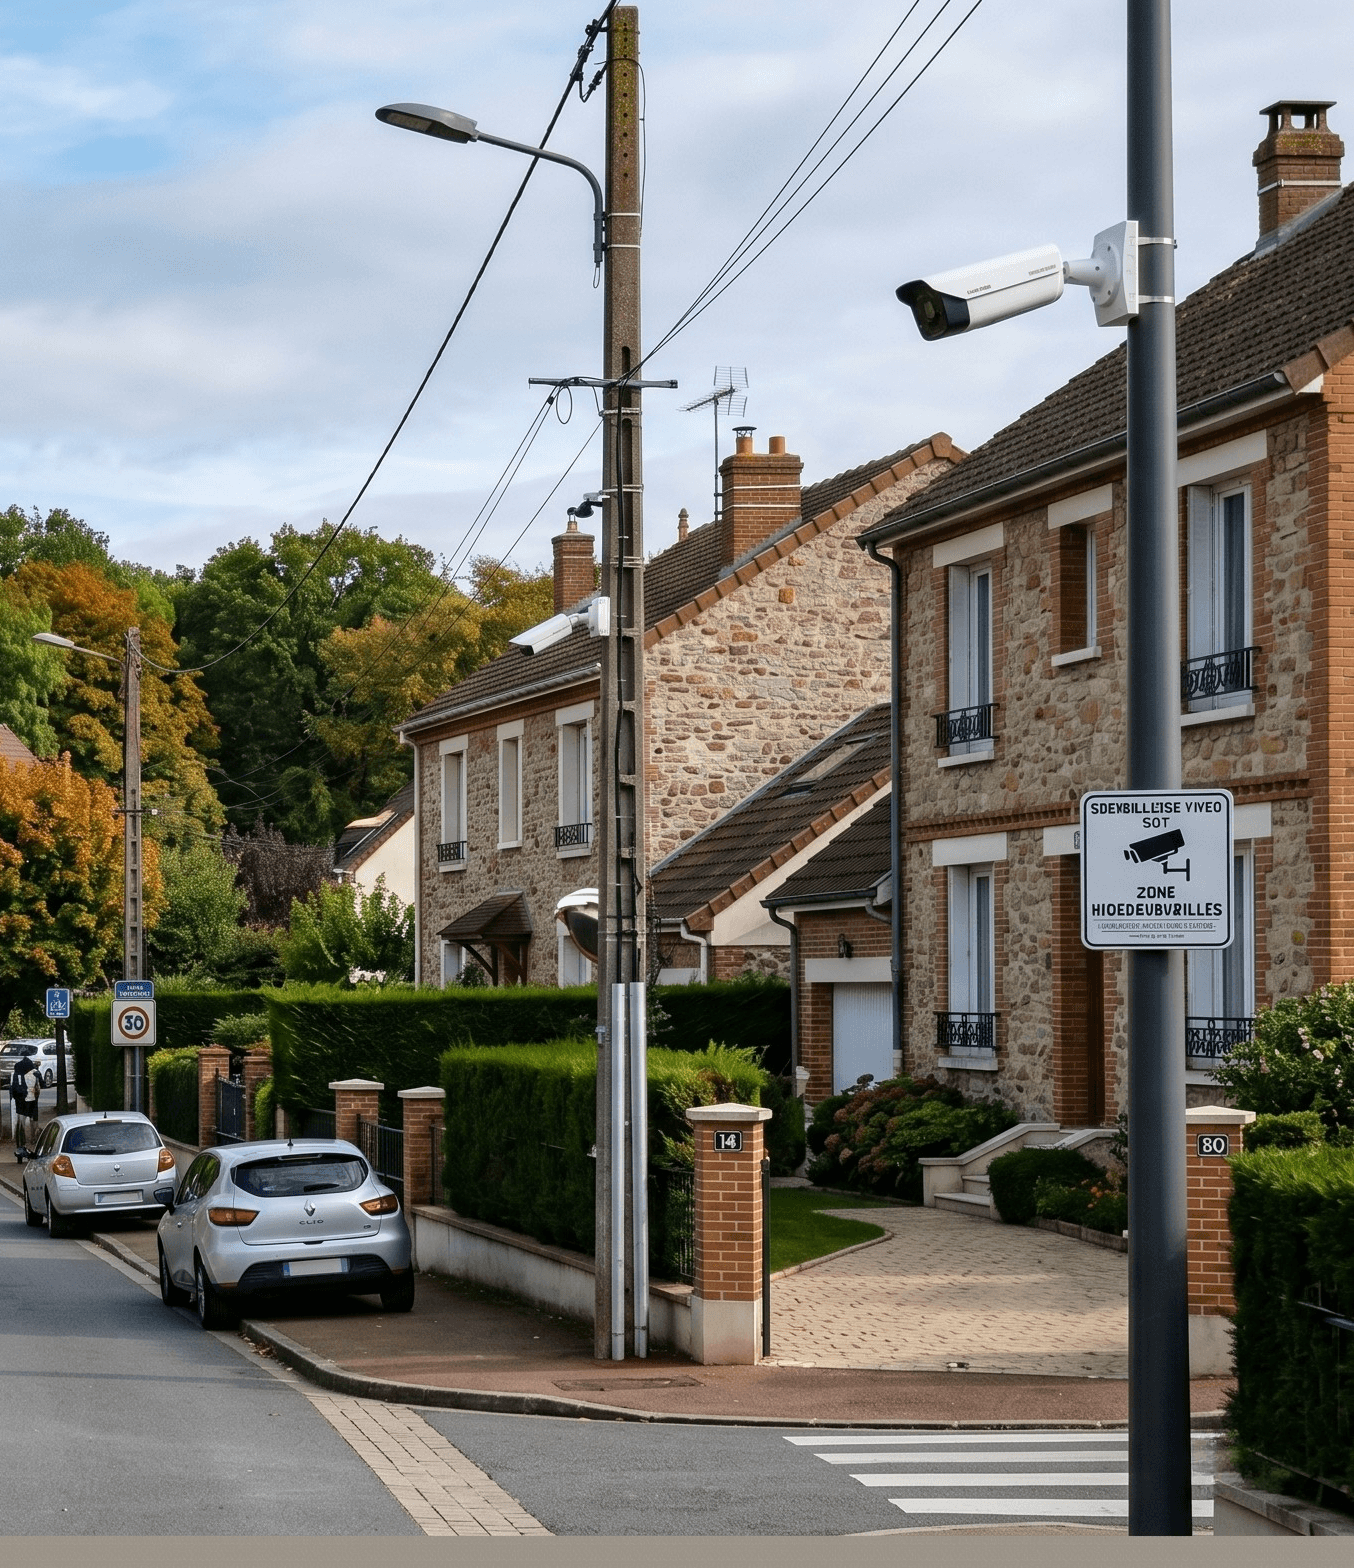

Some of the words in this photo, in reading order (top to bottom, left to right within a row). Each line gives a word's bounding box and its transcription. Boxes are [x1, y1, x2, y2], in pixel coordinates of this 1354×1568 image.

[1142, 817, 1170, 828] SOT
[1136, 886, 1175, 898] ZONE
[124, 1015, 144, 1030] 30
[1202, 1137, 1225, 1153] 80
